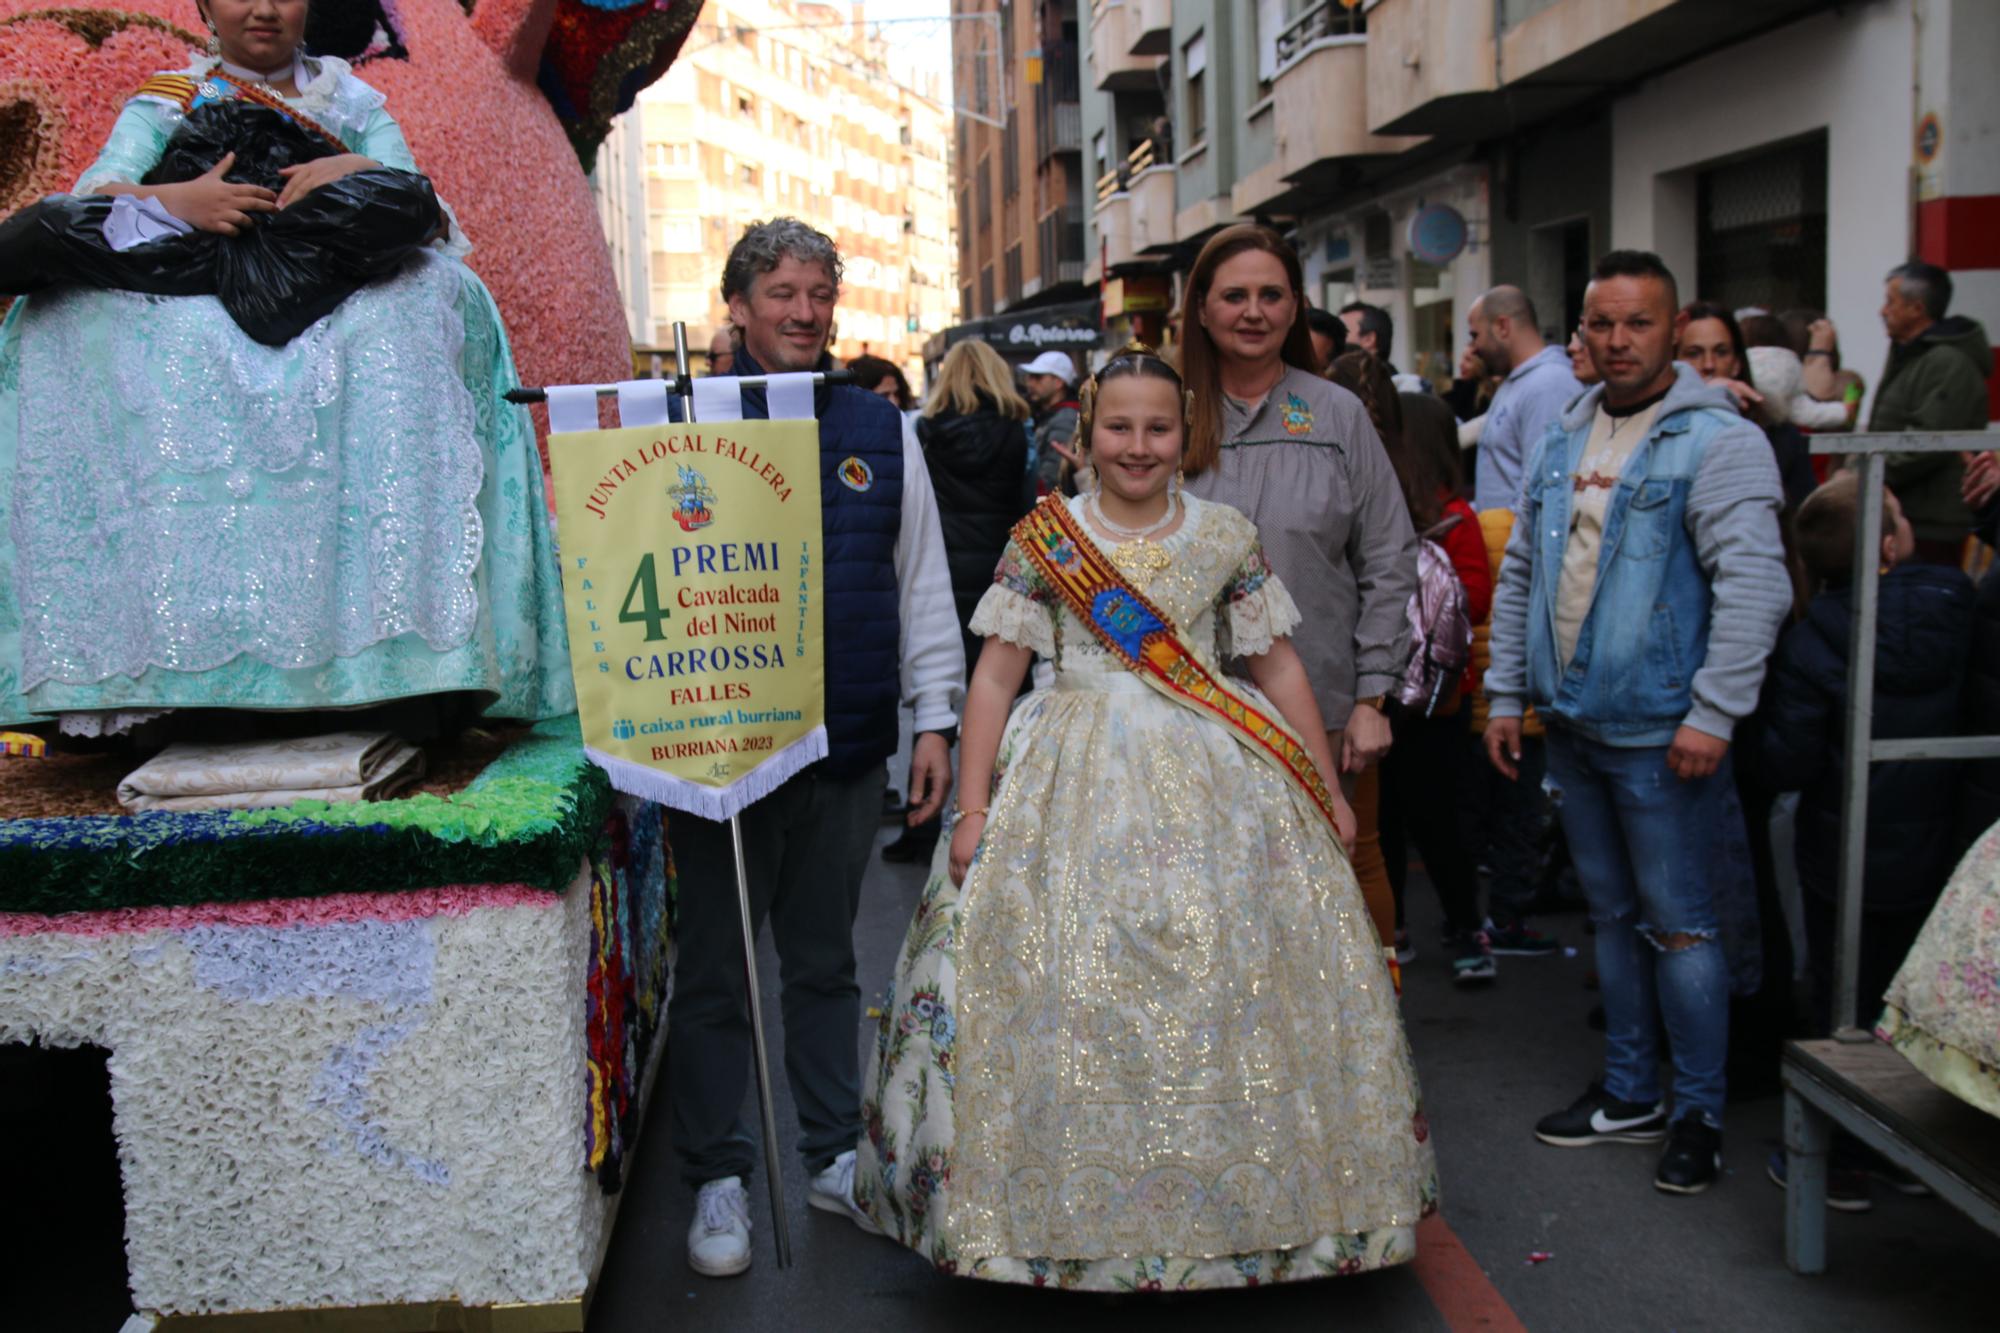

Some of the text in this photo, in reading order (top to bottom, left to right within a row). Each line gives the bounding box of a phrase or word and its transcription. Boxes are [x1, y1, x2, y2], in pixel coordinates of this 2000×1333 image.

[585, 434, 792, 520] JUNTA LOCAL FALLERA
[672, 542, 779, 577] PREMI
[618, 552, 671, 643] 4
[677, 583, 780, 608] Cavalcada
[796, 542, 809, 657] INFANTILS
[577, 557, 610, 673] FALLES
[686, 612, 776, 638] del Ninot
[625, 643, 785, 681] CARROSSA
[671, 682, 752, 705] FALLES
[640, 708, 801, 735] caixa rural burriana
[651, 736, 773, 761] BURRIANA 2023
